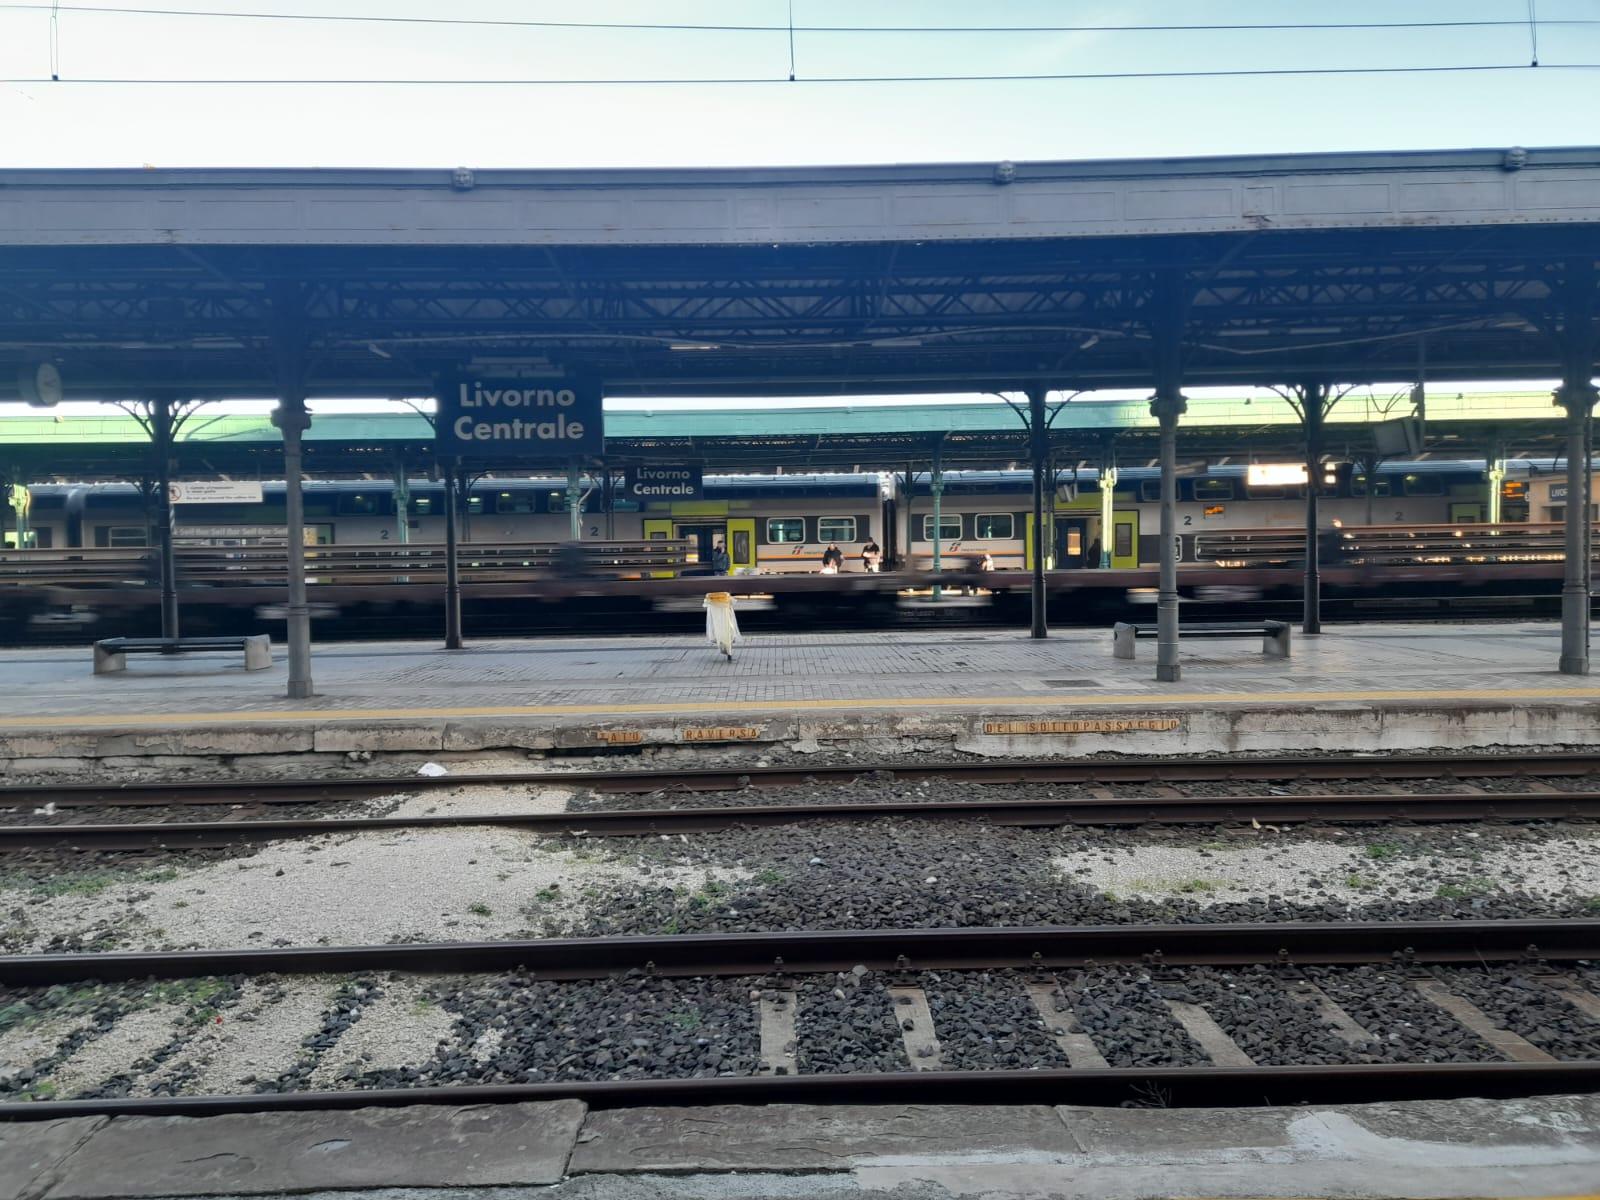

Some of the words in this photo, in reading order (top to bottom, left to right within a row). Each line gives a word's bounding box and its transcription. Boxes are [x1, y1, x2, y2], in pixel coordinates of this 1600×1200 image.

[460, 381, 576, 407] Livorno
[454, 413, 585, 440] Centrale
[637, 467, 690, 479] Livorno
[633, 482, 694, 495] Centrale
[1183, 515, 1192, 526] 2
[1395, 511, 1404, 521] 2
[380, 530, 389, 540] 2
[590, 526, 599, 537] 2
